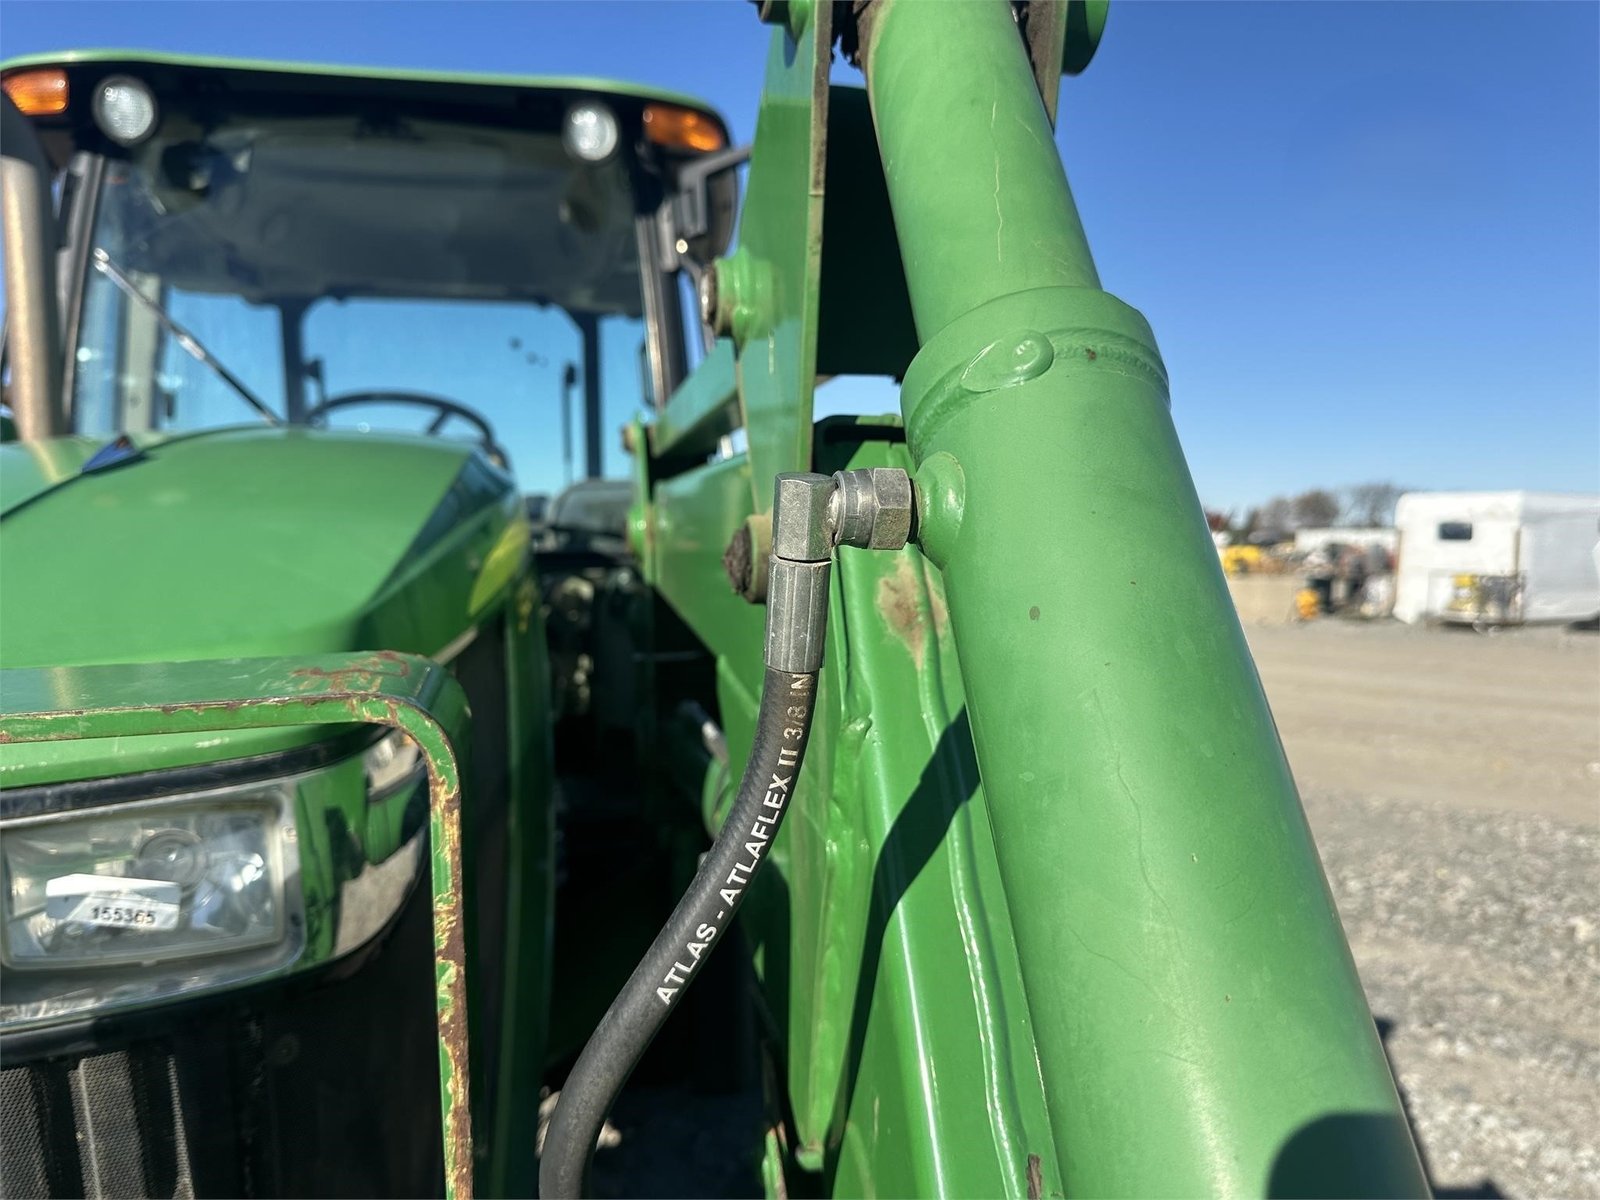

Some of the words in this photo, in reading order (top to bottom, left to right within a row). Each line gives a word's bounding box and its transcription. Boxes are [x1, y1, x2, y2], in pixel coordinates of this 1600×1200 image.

[783, 705, 807, 740] 3/8
[777, 746, 799, 767] II
[719, 773, 792, 907] ATLAFLEX
[92, 907, 156, 925] 155365
[656, 923, 717, 1005] ATLAS
